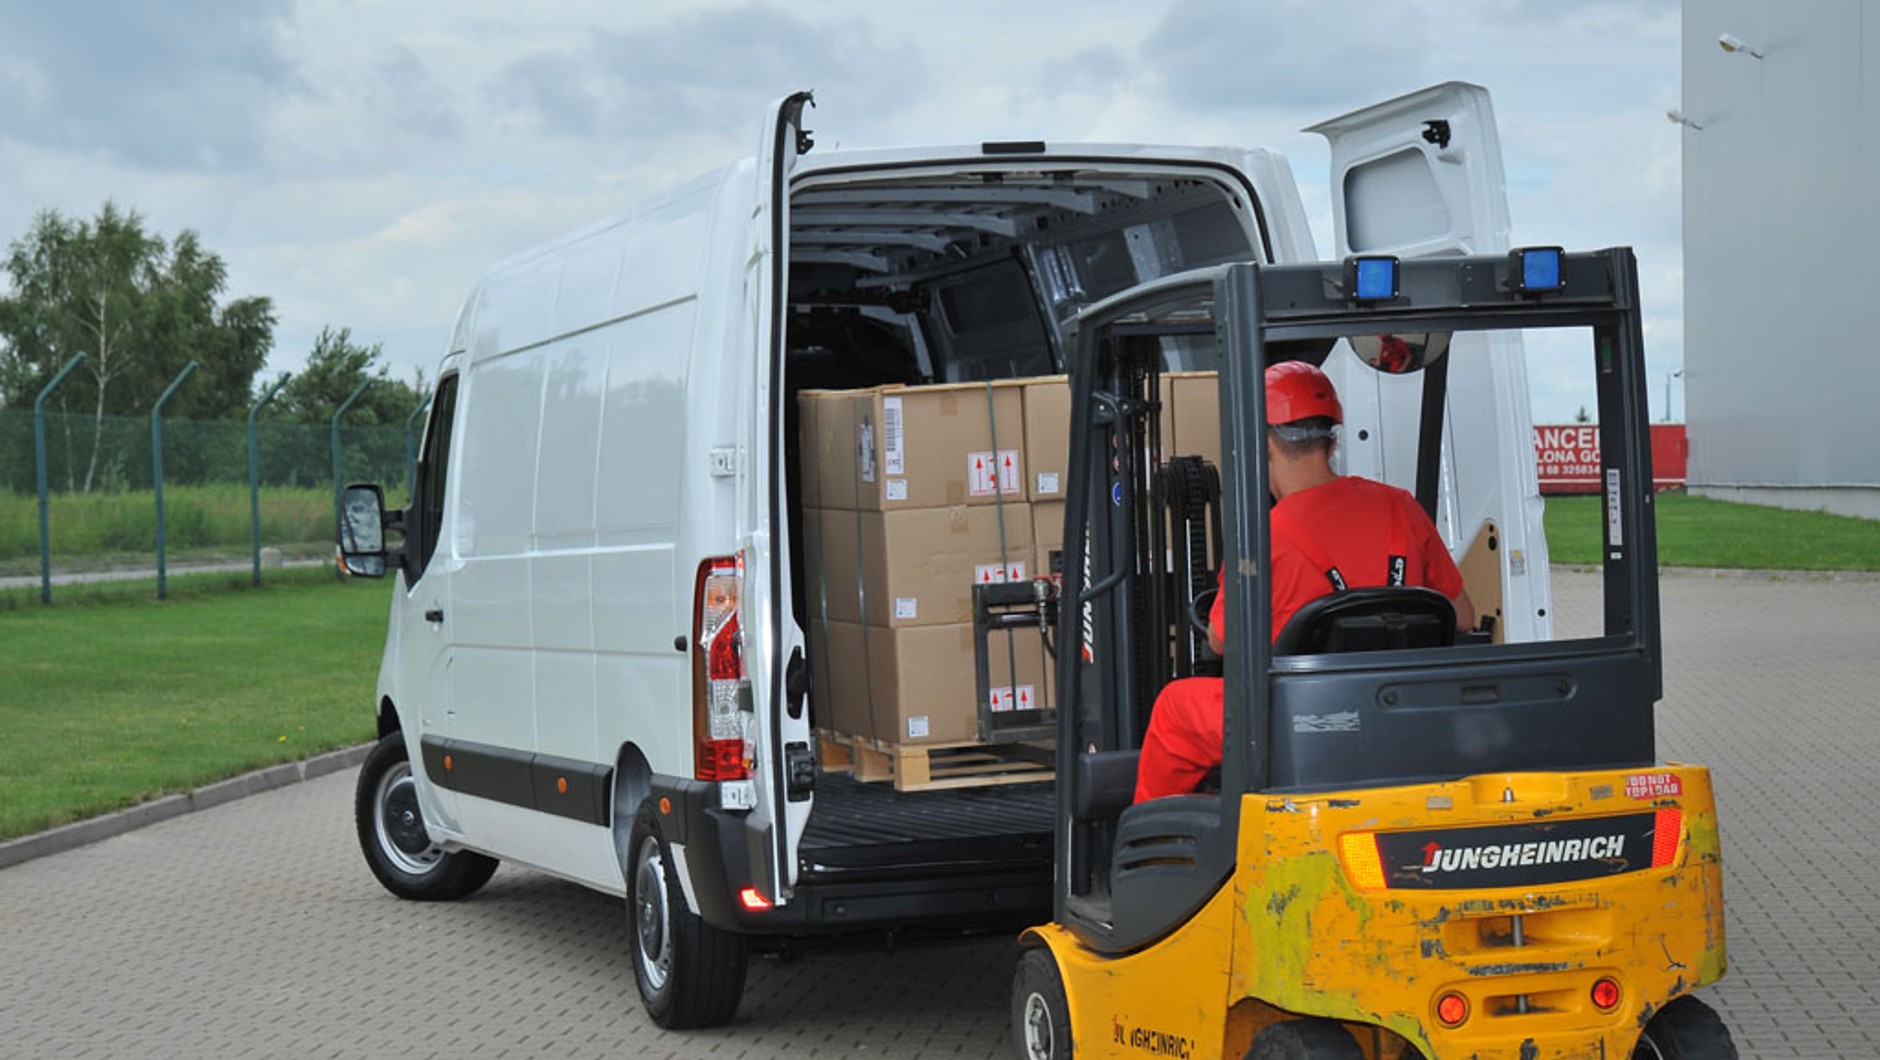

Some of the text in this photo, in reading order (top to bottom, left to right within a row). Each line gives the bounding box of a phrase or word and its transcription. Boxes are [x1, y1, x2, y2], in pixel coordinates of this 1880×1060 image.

[1533, 428, 1600, 448] ANCE
[1648, 774, 1671, 785] NOT
[1626, 784, 1678, 797] TOP LOAD
[1422, 834, 1625, 873] JUNGHEINRICH
